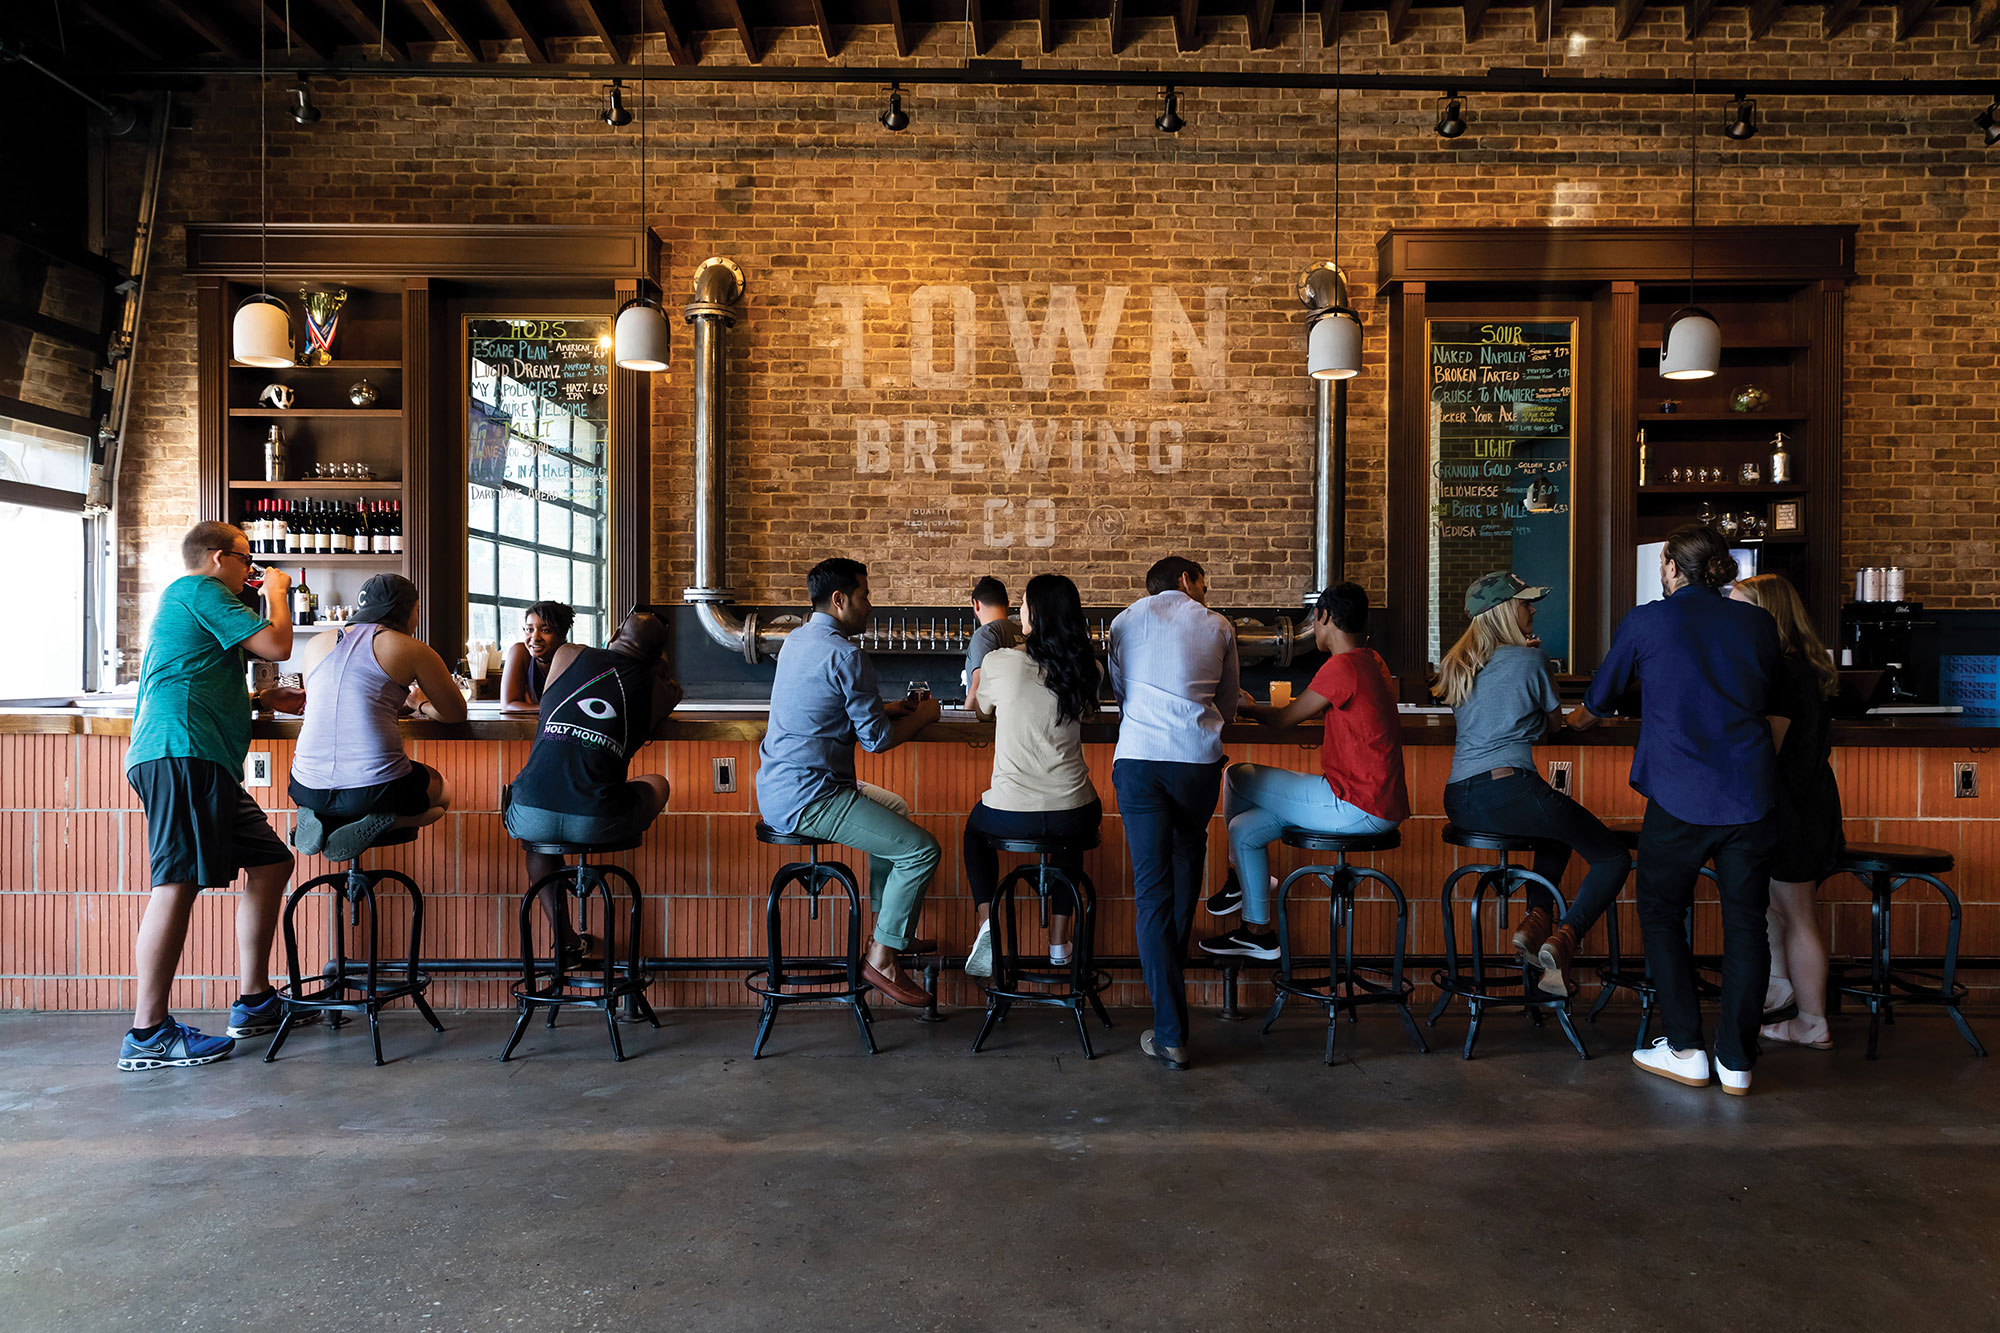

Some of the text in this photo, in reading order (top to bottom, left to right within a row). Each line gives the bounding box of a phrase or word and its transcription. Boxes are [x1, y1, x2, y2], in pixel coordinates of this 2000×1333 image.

[511, 321, 567, 339] HOPS
[814, 284, 1229, 391] TOWN
[1481, 325, 1522, 343] SOUR
[473, 340, 514, 358] ESCAPE
[518, 341, 547, 360] PLAN
[555, 342, 590, 352] AMERICAN
[1433, 346, 1473, 364] NAKED
[1480, 346, 1526, 364] NAPOLEN
[474, 360, 510, 379] LUCID
[513, 358, 561, 379] DREAMZ
[1434, 366, 1477, 384] BROKEN
[1479, 366, 1520, 384] TARTED
[472, 381, 489, 397] MY
[493, 379, 558, 397] APOLOGIES
[566, 382, 588, 393] HAZY
[566, 392, 584, 400] IPA
[1431, 386, 1472, 403] CRUISE
[1478, 387, 1490, 403] TO
[1493, 386, 1536, 403] NOWHERE
[532, 399, 588, 418] WELCOME
[1435, 406, 1467, 423] PUCKER
[1471, 405, 1493, 423] YOUR
[1499, 405, 1518, 423] AXE
[504, 420, 554, 441] MALT
[856, 420, 1183, 474] BREWING
[1475, 439, 1516, 457] LIGHT
[542, 463, 570, 478] HALF
[1433, 460, 1479, 479] GRANDIN
[1484, 460, 1512, 478] GOLD
[1547, 461, 1568, 473] 5.0%
[1452, 500, 1483, 518] BIERE
[1486, 505, 1498, 516] DE
[1501, 501, 1528, 519] VILLE
[983, 498, 1056, 547] CO
[1432, 521, 1477, 538] MEDUSA
[357, 590, 367, 607] C
[544, 724, 624, 759] HOLY MOUNTAIN
